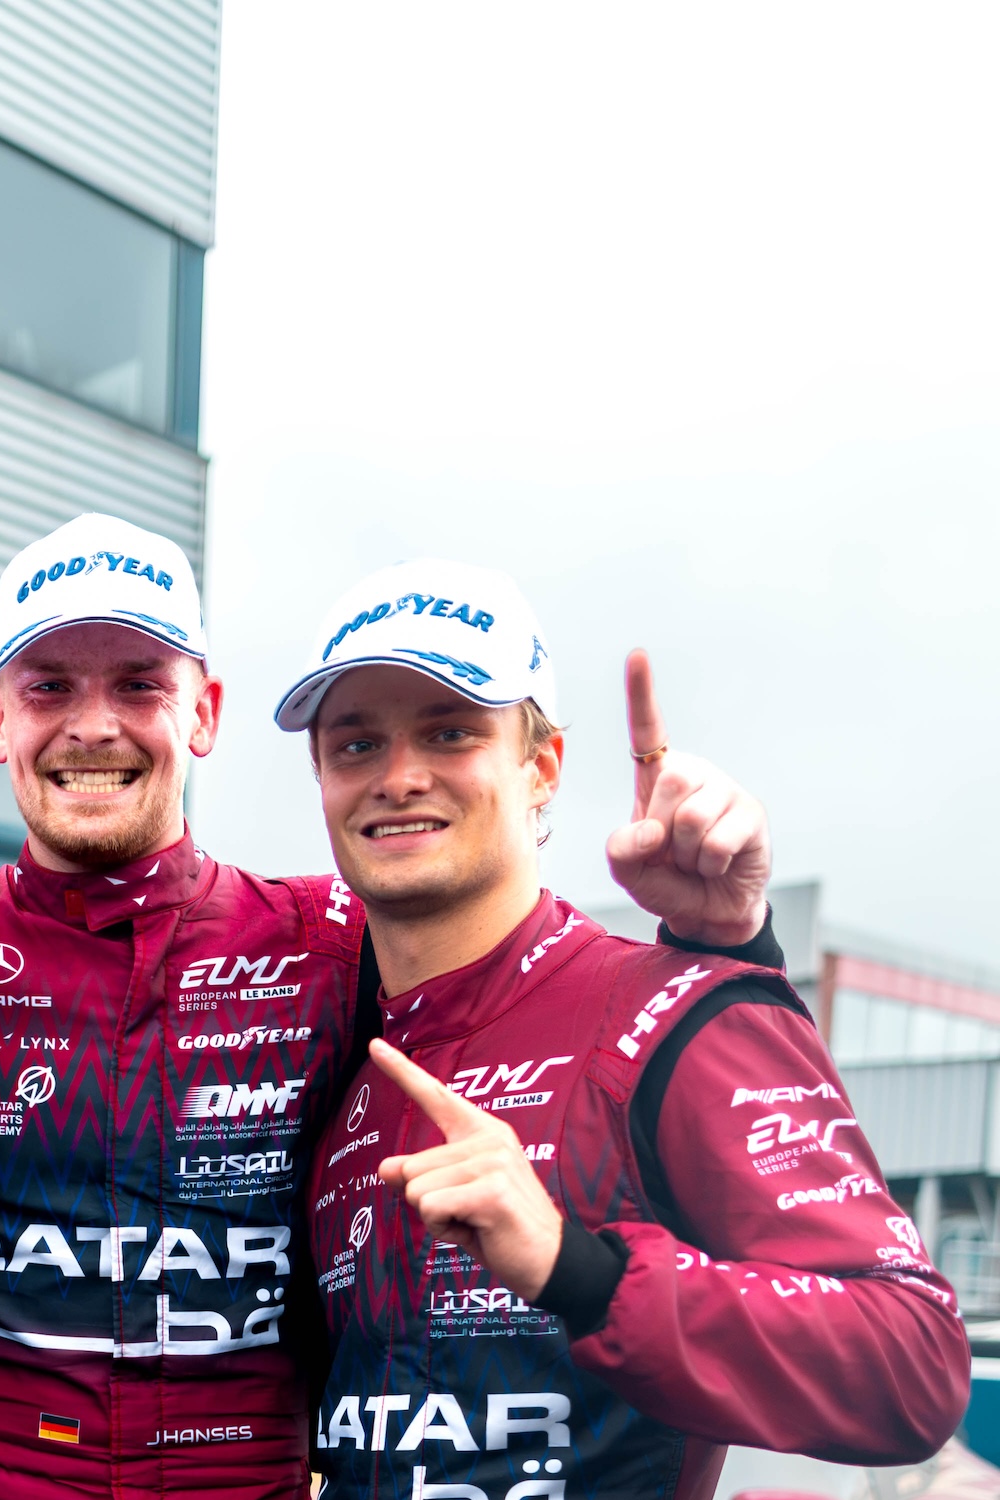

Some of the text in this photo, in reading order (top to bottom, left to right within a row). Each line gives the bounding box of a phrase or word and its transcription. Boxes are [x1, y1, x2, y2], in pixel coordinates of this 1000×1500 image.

[179, 986, 294, 1003] EUROPEAN LE MANS
[179, 1001, 218, 1012] SERIES
[617, 964, 713, 1060] HRX
[20, 1037, 70, 1050] LYNX
[497, 1099, 509, 1108] LE
[513, 1094, 543, 1105] MANS
[344, 1131, 379, 1156] AMG
[752, 1142, 818, 1168] EUROPEAN
[757, 1158, 799, 1176] SERIES
[179, 1178, 263, 1189] INTERNATIONAL
[333, 1250, 354, 1266] QATAR
[327, 1276, 355, 1293] ACADEMY
[509, 1315, 558, 1324] CIRCUIT
[317, 1392, 572, 1452] ATAR
[146, 1425, 253, 1446] J.HANSES
